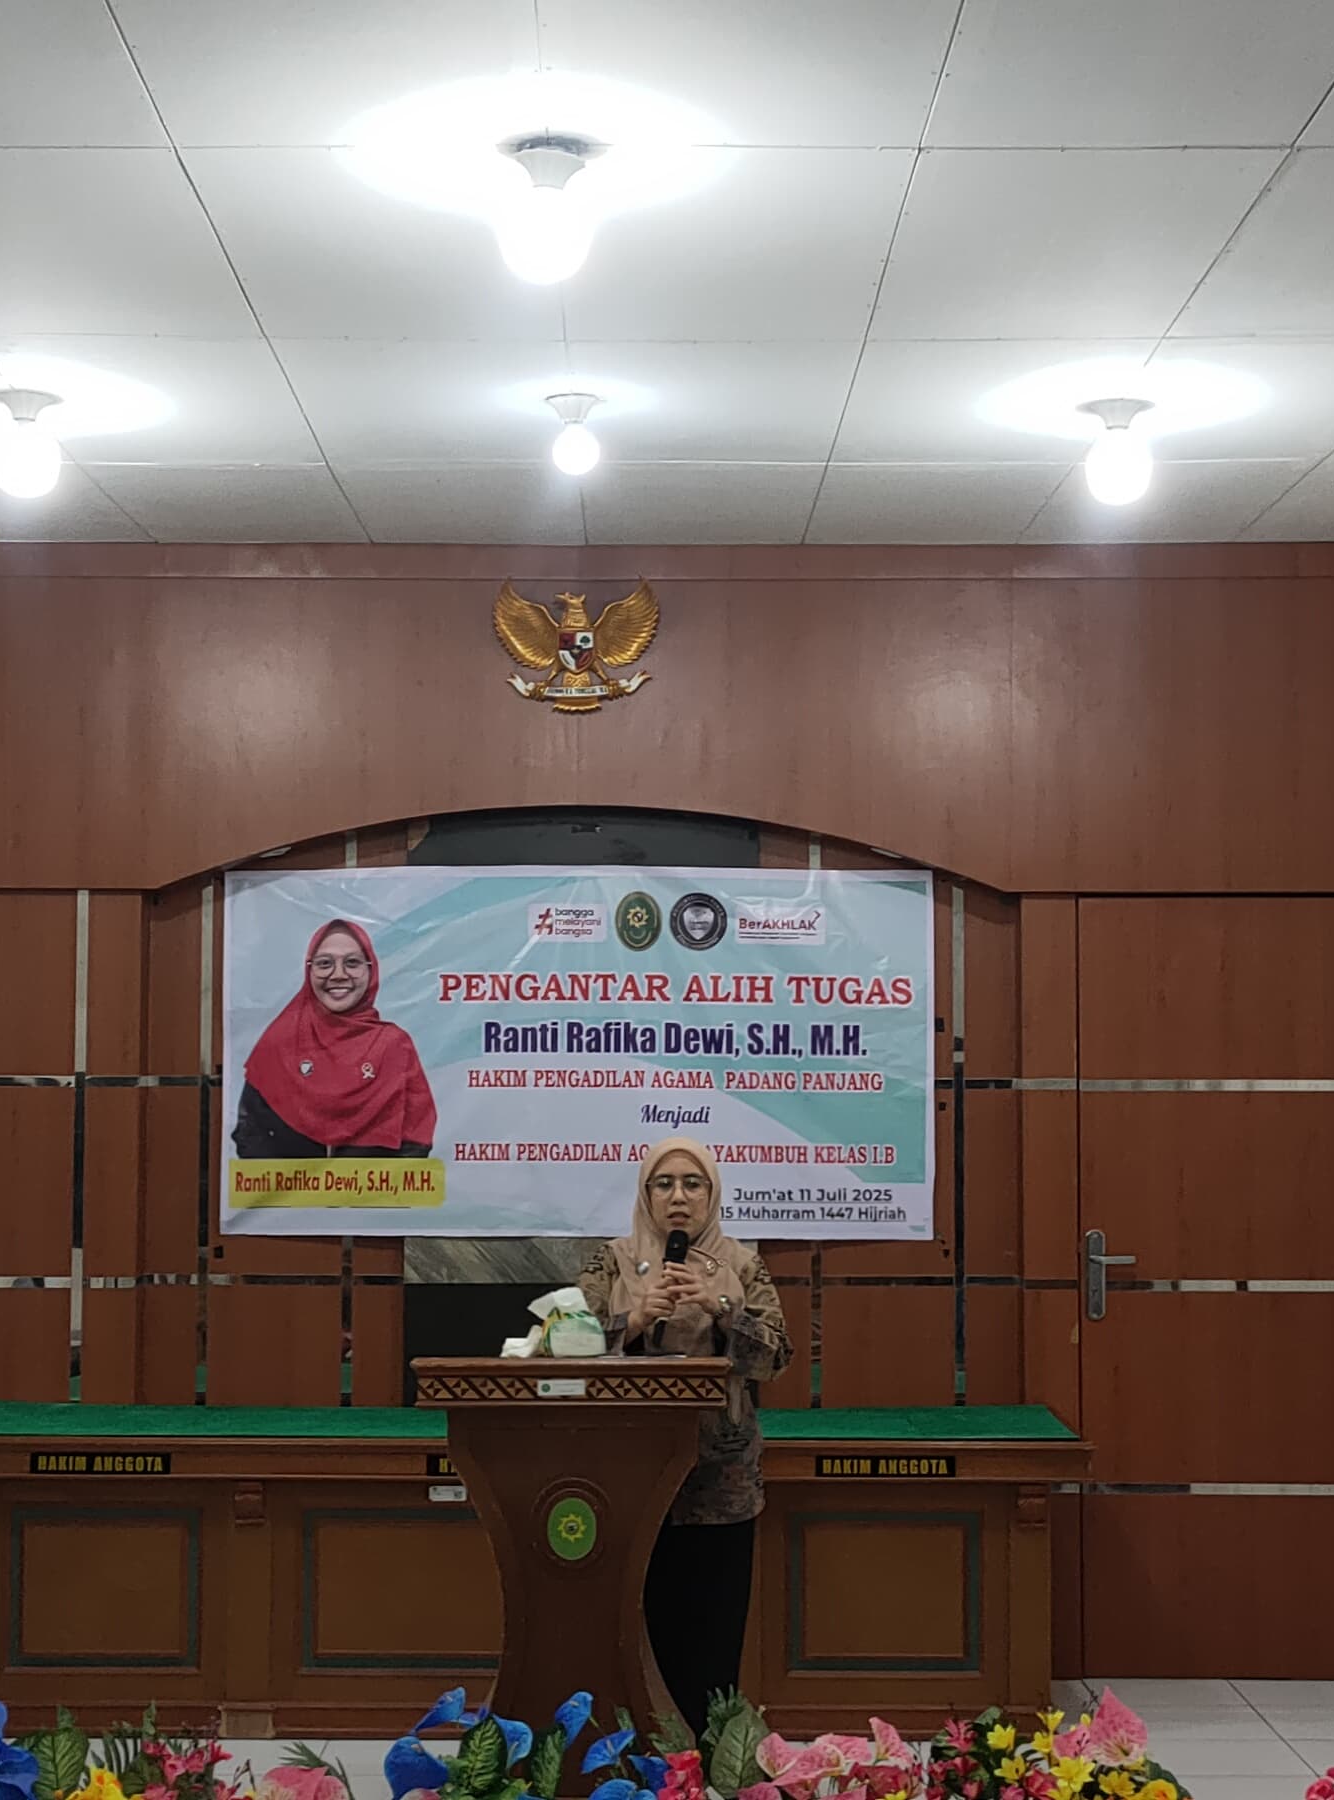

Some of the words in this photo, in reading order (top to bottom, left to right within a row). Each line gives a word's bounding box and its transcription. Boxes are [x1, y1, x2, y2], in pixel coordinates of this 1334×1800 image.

[555, 908, 594, 918] bangga
[555, 917, 602, 927] melayani
[739, 917, 817, 931] BerAKHLAK
[555, 927, 593, 937] bangsa
[439, 974, 671, 1002] PENGANTAR
[683, 975, 774, 1003] ALIH
[787, 976, 913, 1005] TUGAS
[484, 1021, 558, 1053] Ranti
[567, 1021, 656, 1053] Rafika
[664, 1022, 740, 1058] Dewi,
[747, 1023, 803, 1058] S.H.,
[810, 1024, 868, 1056] M.H.
[468, 1070, 527, 1088] HAKIM
[533, 1070, 645, 1088] PENGADILAN
[651, 1071, 714, 1089] AGAMA
[725, 1072, 796, 1090] PADANG
[802, 1073, 883, 1091] PANJANG
[641, 1104, 710, 1129] Menjadi
[455, 1143, 510, 1161] HAKIM
[517, 1143, 622, 1162] PENGADILAN
[705, 1145, 808, 1163] YAKUMBUH
[814, 1145, 867, 1164] KELAS
[873, 1146, 895, 1164] I.B
[235, 1172, 271, 1192] Ranti
[275, 1170, 320, 1192] Rafika
[325, 1170, 362, 1195] Dewi,
[367, 1170, 398, 1195] S.H.,
[403, 1170, 435, 1192] M.H.
[734, 1188, 793, 1201] Jum'at
[799, 1189, 811, 1201] 11
[817, 1188, 847, 1202] Juli
[853, 1189, 892, 1202] 2025
[720, 1207, 733, 1219] 15
[739, 1207, 815, 1220] Muharram
[820, 1207, 853, 1220] 1447
[858, 1207, 906, 1222] Hijriah
[38, 1456, 87, 1471] HAKIM
[93, 1456, 163, 1472] ANGGOTA
[822, 1459, 871, 1474] HAKIM
[878, 1459, 948, 1475] ANGGOTA
